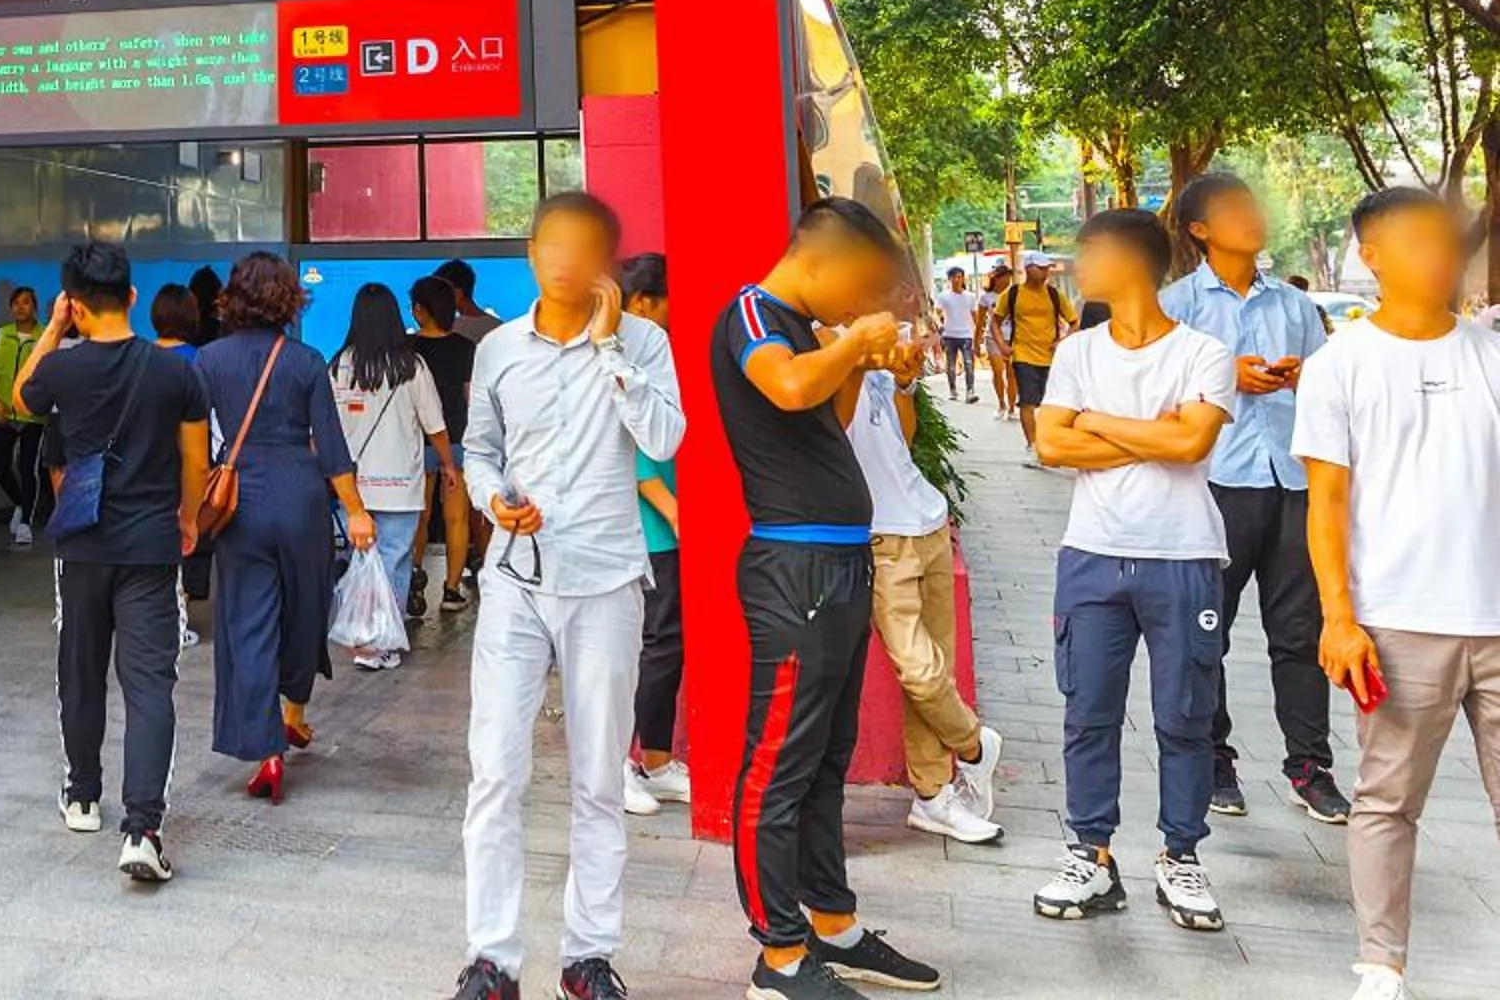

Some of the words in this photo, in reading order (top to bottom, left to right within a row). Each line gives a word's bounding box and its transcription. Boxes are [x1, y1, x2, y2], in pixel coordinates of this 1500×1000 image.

[38, 40, 59, 55] and
[173, 33, 203, 47] when
[209, 34, 232, 47] you
[300, 30, 344, 46] 1号线
[451, 36, 504, 60] 入口
[98, 57, 127, 70] with
[195, 54, 226, 66] more
[231, 51, 260, 65] than
[407, 39, 439, 75] D
[38, 79, 59, 93] and
[65, 78, 106, 92] height
[111, 78, 141, 89] more
[147, 75, 175, 88] than
[222, 71, 246, 85] and
[252, 69, 275, 84] the
[299, 67, 346, 83] 2号线
